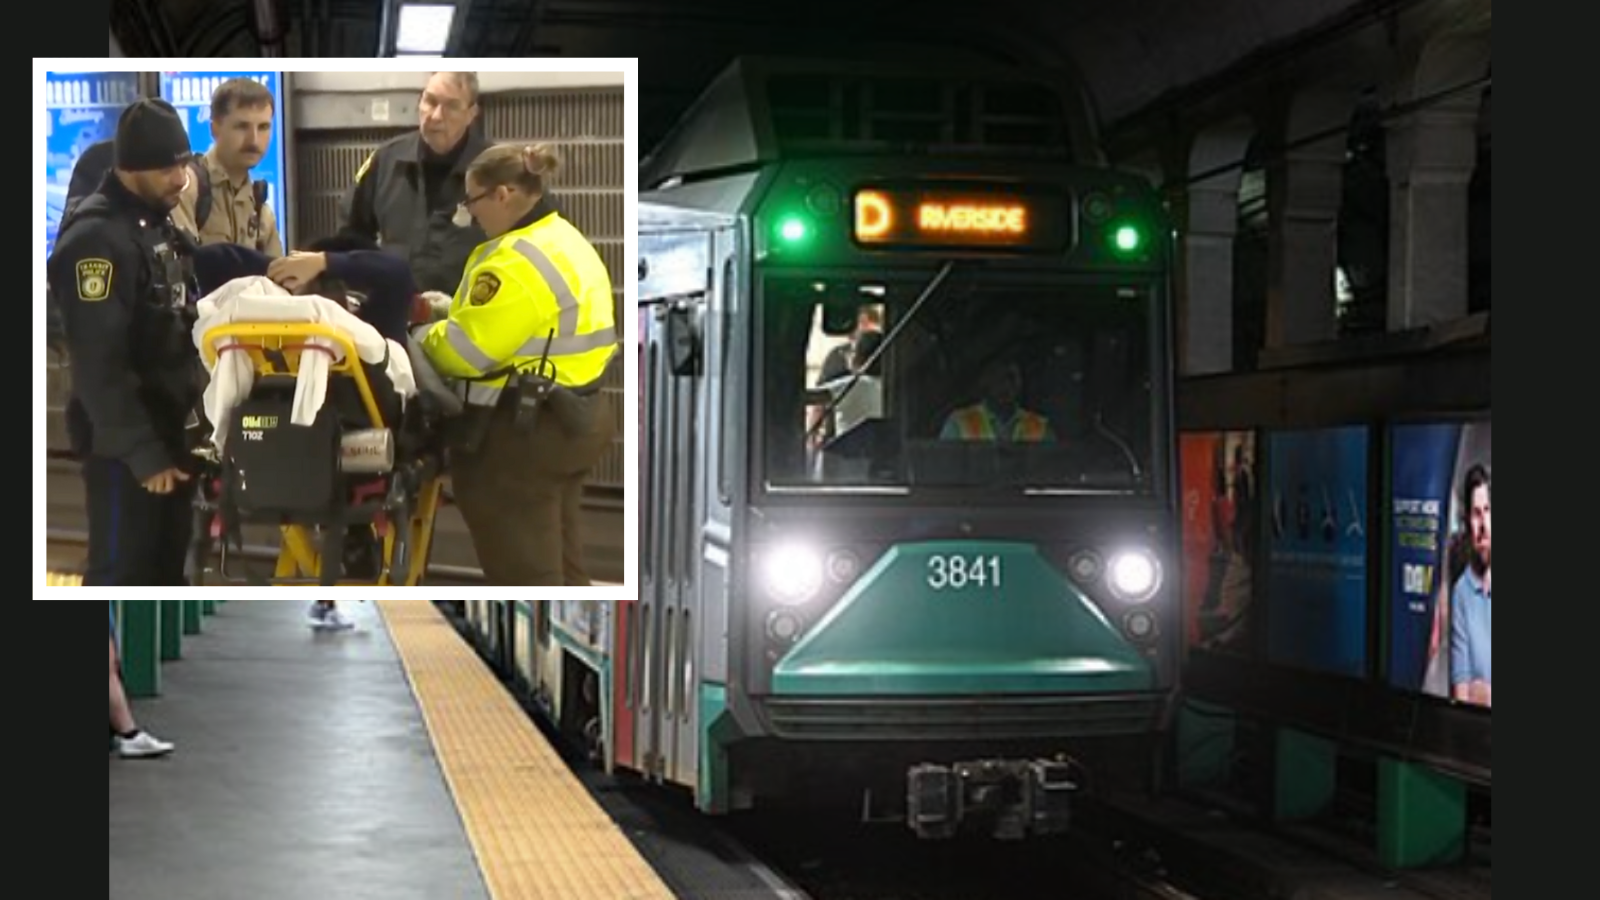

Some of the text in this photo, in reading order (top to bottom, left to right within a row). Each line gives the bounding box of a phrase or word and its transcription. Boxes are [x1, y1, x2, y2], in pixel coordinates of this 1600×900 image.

[855, 190, 1026, 241] D RIVERSIDE
[242, 430, 264, 441] ZOLL
[927, 555, 1000, 589] 3841
